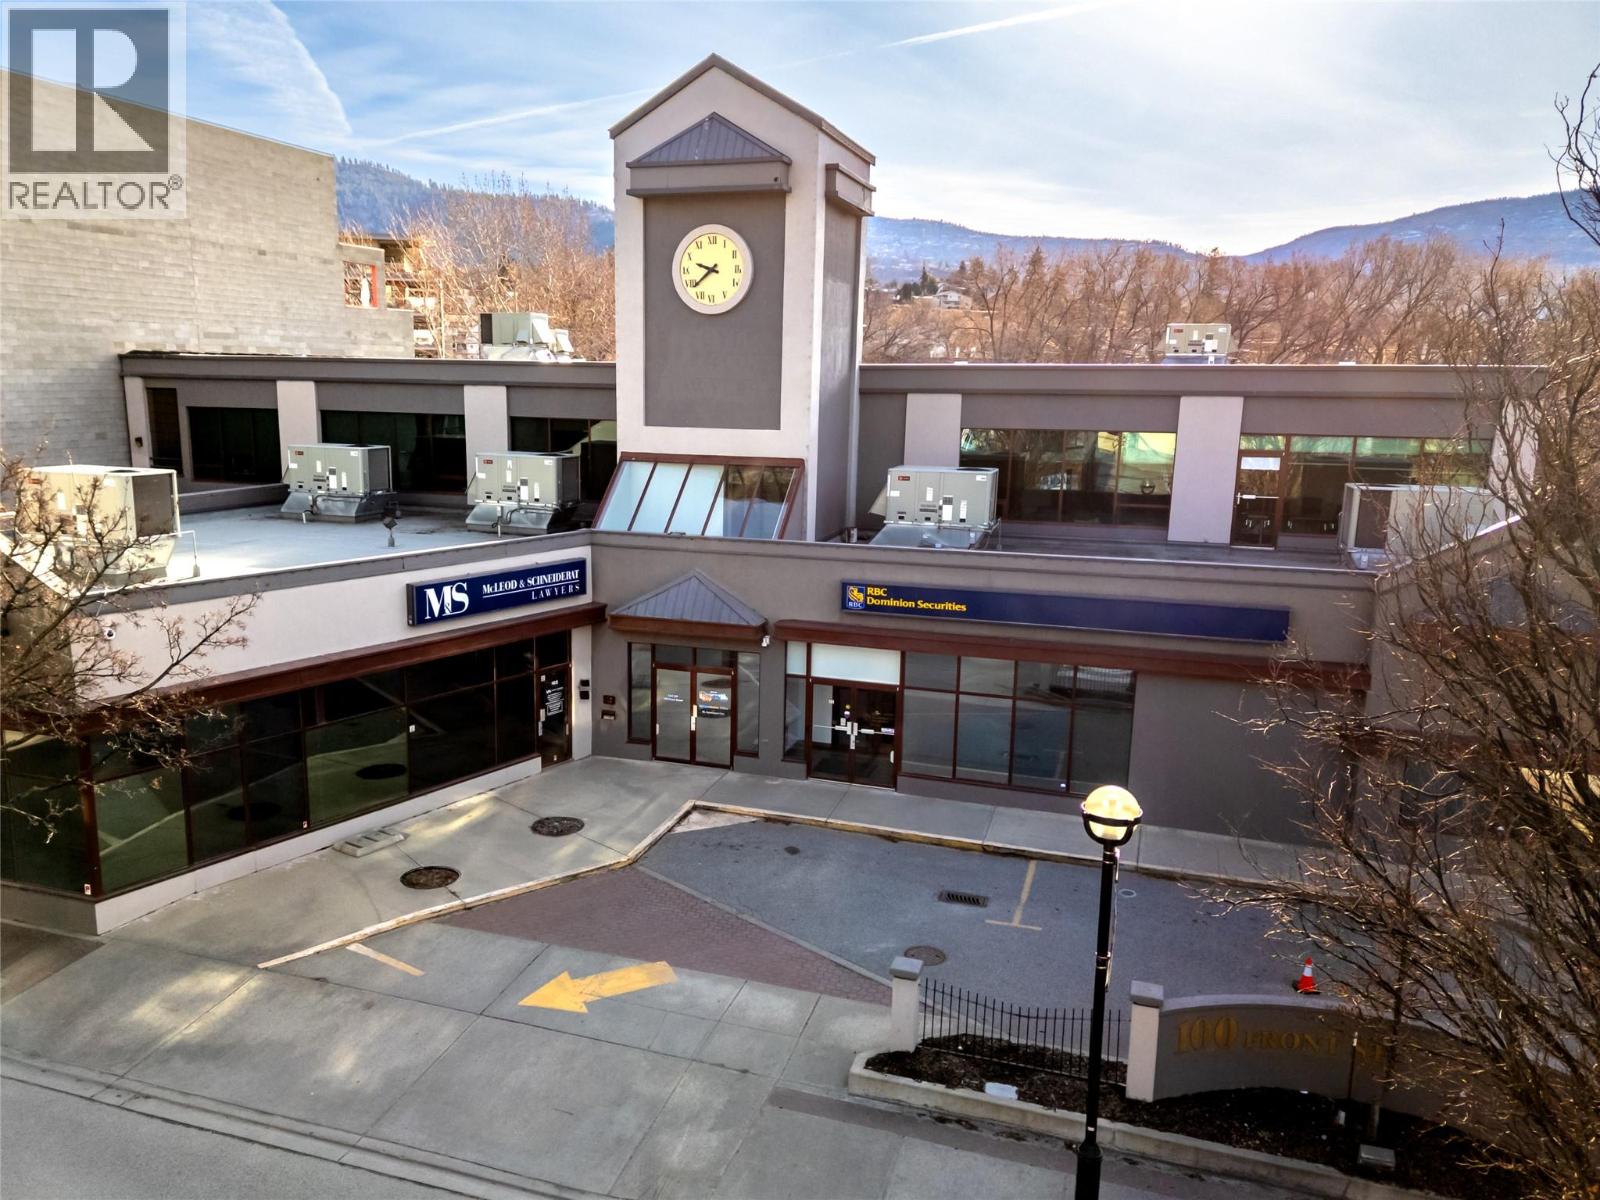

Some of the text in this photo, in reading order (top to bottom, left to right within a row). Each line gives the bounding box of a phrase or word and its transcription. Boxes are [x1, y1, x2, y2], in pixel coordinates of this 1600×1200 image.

[695, 240, 703, 250] XI
[707, 235, 718, 245] XII
[695, 291, 705, 300] VII
[707, 294, 715, 304] VI
[722, 290, 728, 299] V
[482, 569, 580, 595] McLEOD & SCHNEIDERAT
[531, 583, 580, 600] LAWYERS
[866, 587, 888, 597] RBC
[866, 596, 967, 612] Dominion Securities
[1175, 1014, 1240, 1057] 100
